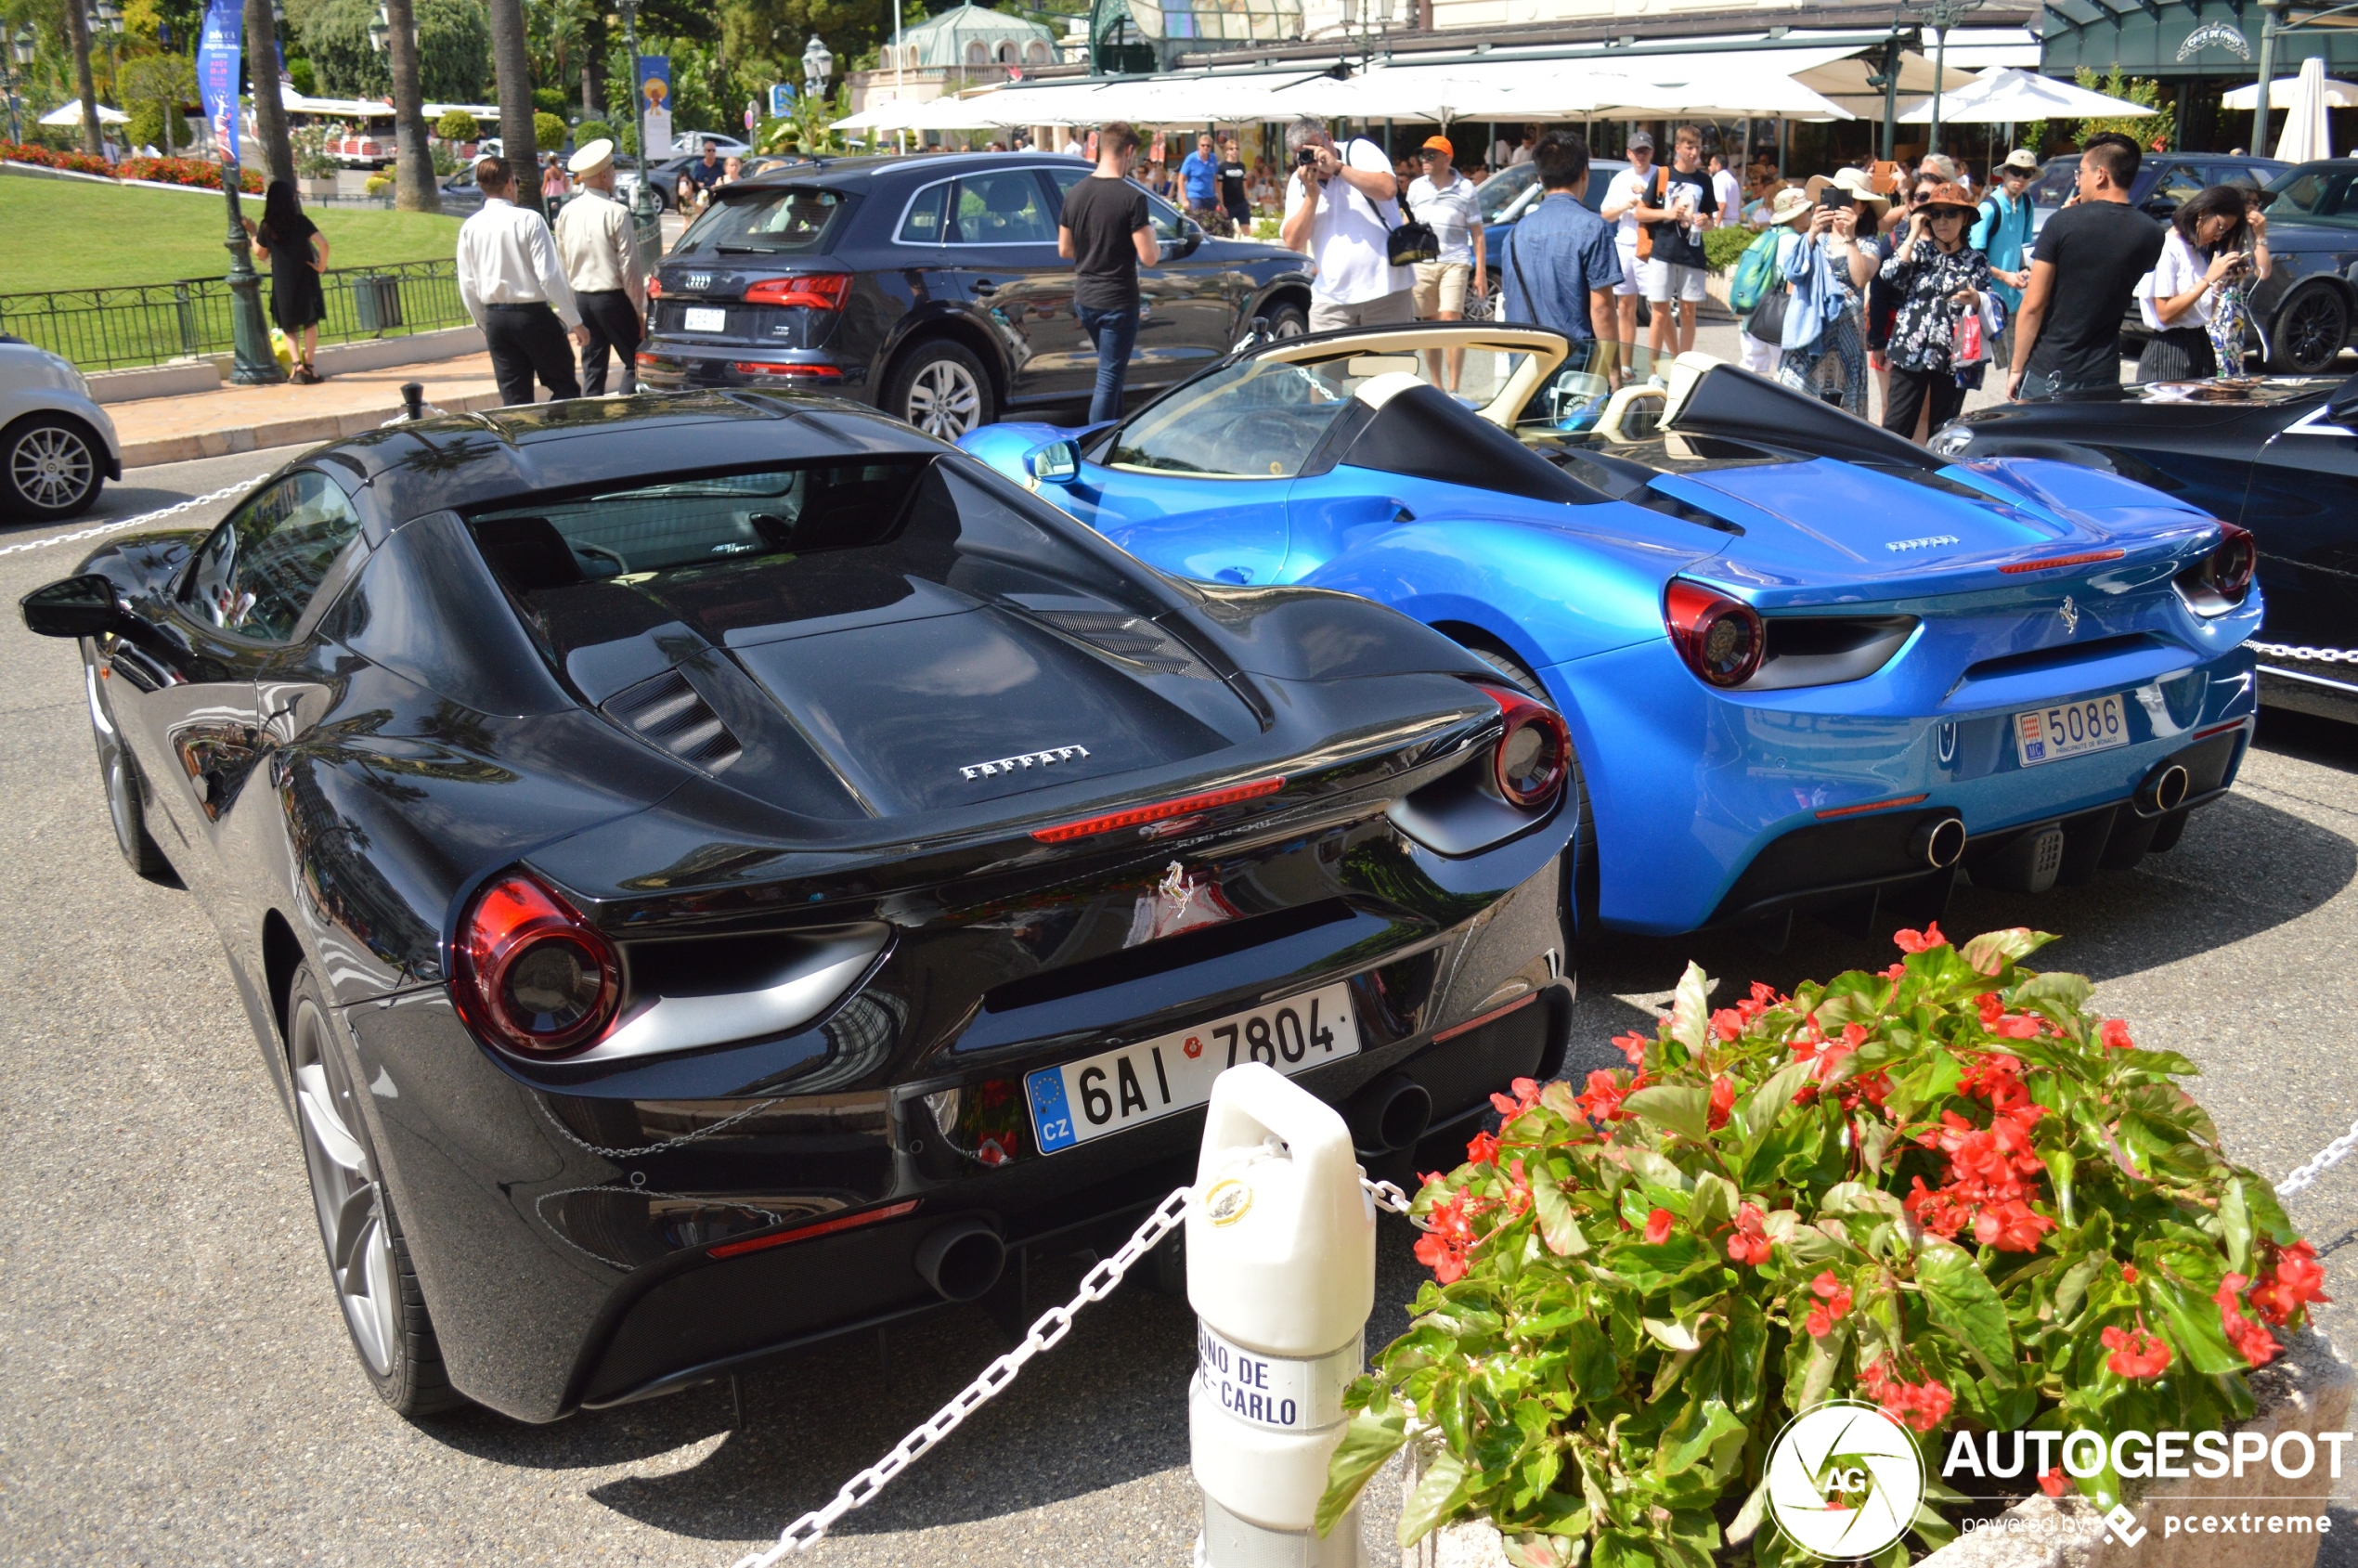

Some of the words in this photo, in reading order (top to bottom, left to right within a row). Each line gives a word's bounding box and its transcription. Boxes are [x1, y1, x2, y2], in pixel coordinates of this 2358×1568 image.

[2209, 30, 2220, 38] DE
[2221, 30, 2242, 46] PARIS
[2048, 699, 2119, 745] 5086
[2028, 744, 2041, 757] MC
[2088, 740, 2096, 748] DE
[2096, 735, 2118, 745] MONACO
[959, 745, 1091, 783] Ferrari
[1079, 1046, 1172, 1126] 6AI
[1211, 997, 1334, 1069] 7804
[1043, 1118, 1069, 1141] CZ
[1238, 1355, 1269, 1390] DE
